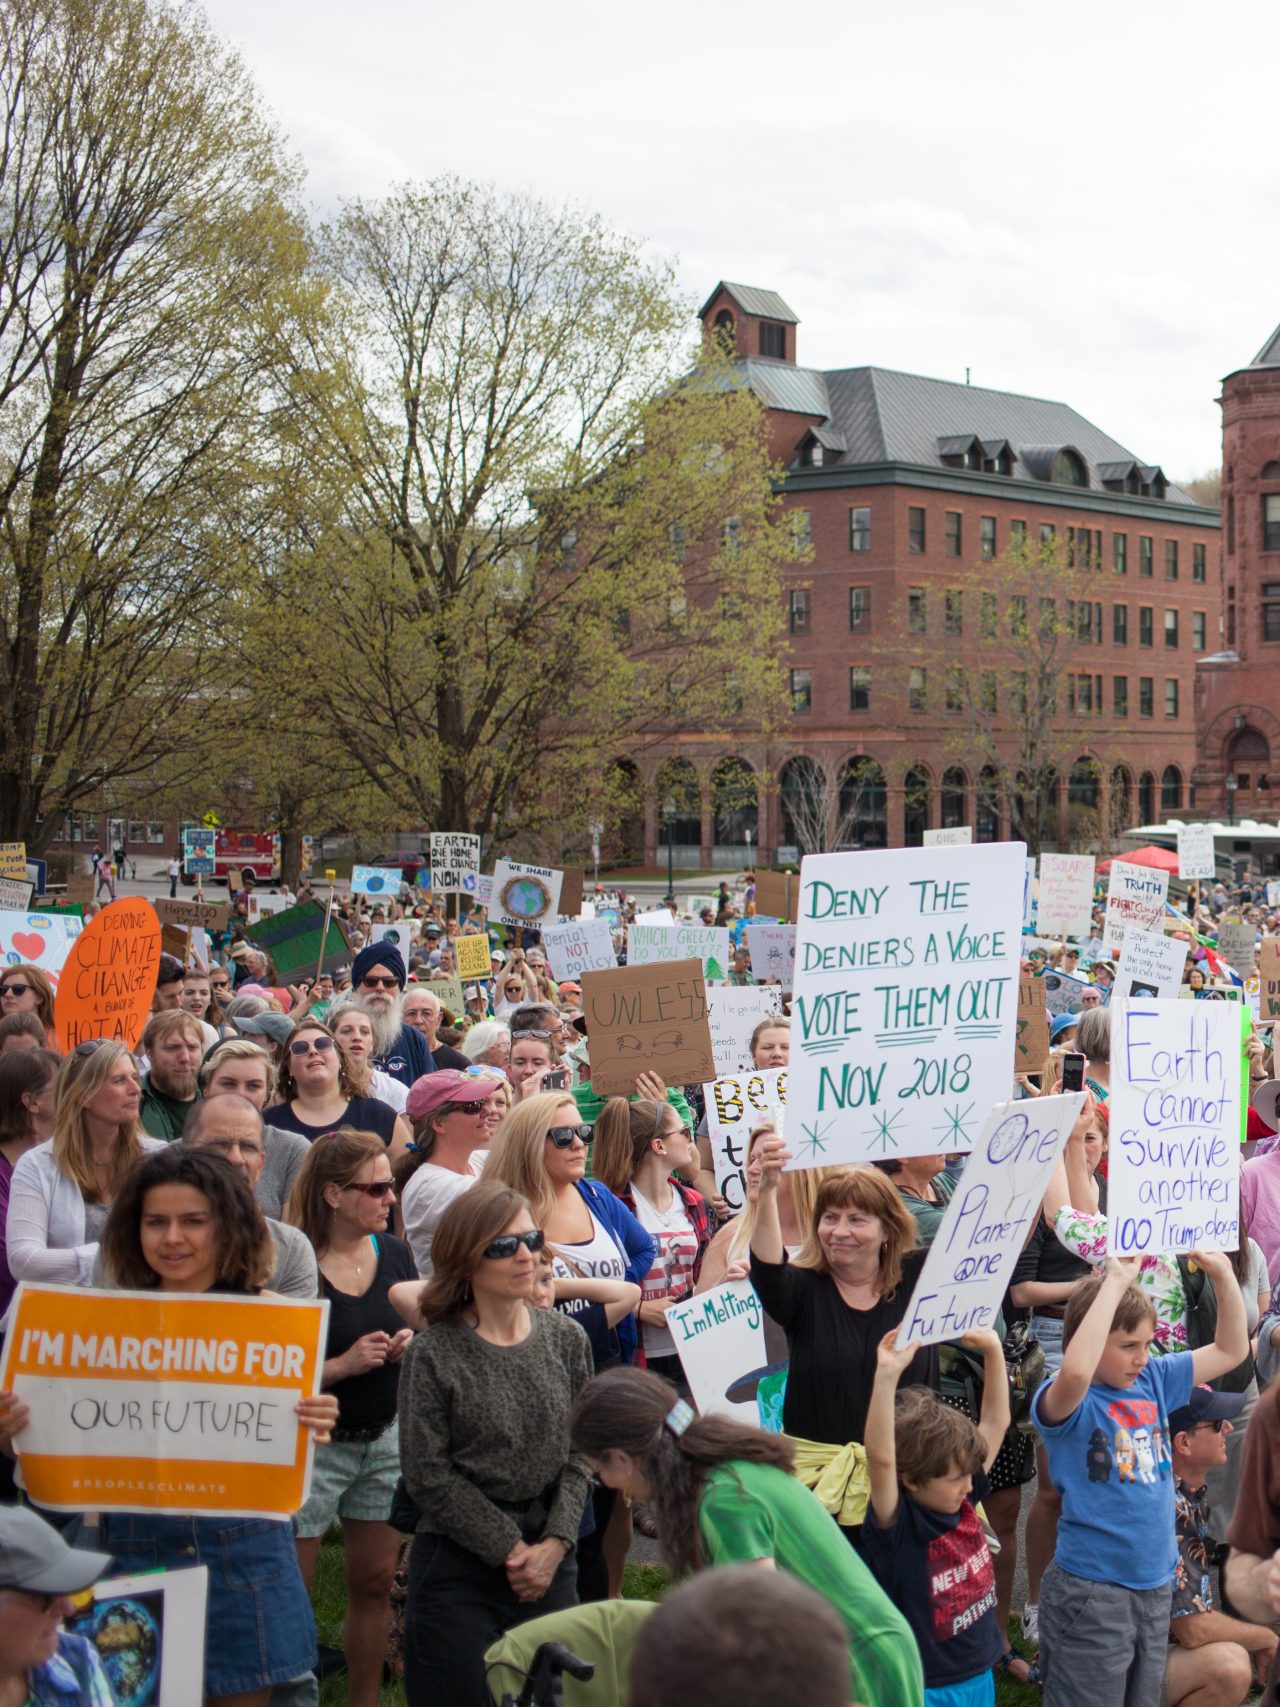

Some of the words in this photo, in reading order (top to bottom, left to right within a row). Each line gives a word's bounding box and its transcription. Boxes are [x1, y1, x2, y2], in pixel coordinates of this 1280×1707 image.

[435, 835, 479, 849] EARTH
[432, 849, 447, 858] ONE
[450, 848, 472, 859] HOME
[432, 858, 447, 868] ONE
[450, 859, 479, 871] CHANCE
[508, 864, 521, 872] WE
[526, 867, 553, 877] SHARE
[1185, 865, 1213, 876] DEAD!
[353, 868, 374, 883] GO
[433, 871, 460, 888] NOW
[1124, 877, 1162, 895] TRUTH
[803, 880, 890, 919] DENY
[909, 880, 971, 913] THE
[194, 904, 217, 918] 100
[103, 912, 147, 932] DENYING
[501, 917, 518, 926] ONE
[522, 920, 543, 929] NEST
[457, 941, 470, 949] RISE
[472, 940, 482, 948] UP
[546, 928, 585, 947] Denial
[633, 927, 667, 945] WHICH
[677, 928, 716, 944] GREEN
[1129, 932, 1149, 943] Save
[77, 933, 160, 968] CLIMATE
[458, 945, 488, 956] AGAINST
[566, 942, 589, 957] NOT
[634, 947, 648, 958] DO
[657, 946, 678, 958] YOU
[801, 936, 915, 972] DENIERS
[924, 933, 939, 964] A
[947, 923, 1006, 962] VOICE
[1134, 944, 1165, 958] Protect
[460, 955, 485, 964] RISING
[460, 962, 488, 971] OCEANS
[566, 955, 612, 974] policy
[105, 1000, 126, 1013] BUNCH
[126, 997, 135, 1009] OF
[592, 979, 705, 1027] UNLESS
[794, 989, 862, 1040] VOTE
[874, 983, 950, 1029] THEM
[957, 977, 1012, 1022] OUT
[67, 1018, 110, 1049] HOT
[112, 1013, 139, 1042] AIR
[1127, 1011, 1223, 1083] Earth
[898, 1053, 972, 1100] 2018
[987, 1113, 1058, 1165] One
[1139, 1170, 1237, 1204] another
[945, 1184, 1027, 1253] Planet
[1114, 1217, 1152, 1251] 100
[1155, 1207, 1202, 1249] Trump
[907, 1294, 993, 1341] Future
[19, 1329, 65, 1366] I'M
[70, 1332, 239, 1373] MARCHING
[243, 1341, 306, 1378] FOR
[71, 1399, 143, 1431] OUR
[152, 1399, 279, 1442] FUTURE
[72, 1479, 227, 1494] #PEOPLESCLIMATE
[932, 1563, 968, 1596] NEW
